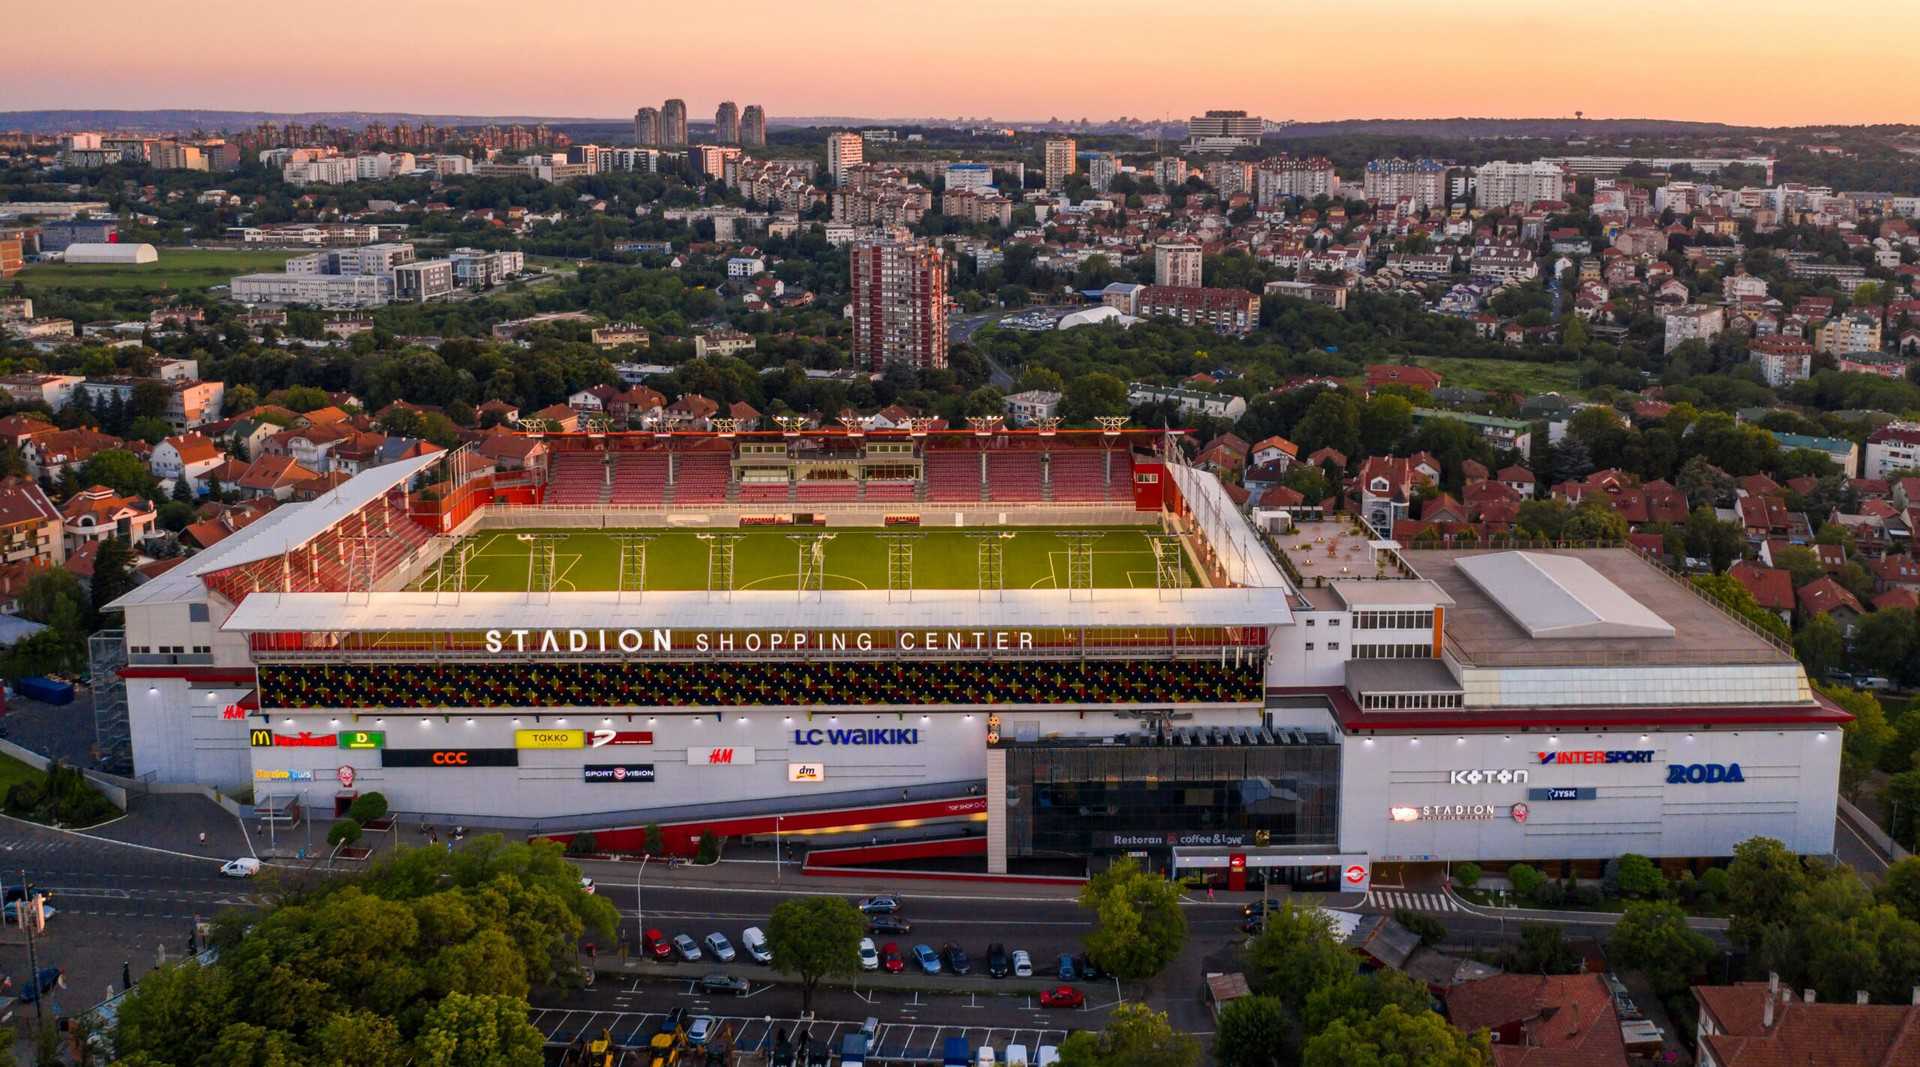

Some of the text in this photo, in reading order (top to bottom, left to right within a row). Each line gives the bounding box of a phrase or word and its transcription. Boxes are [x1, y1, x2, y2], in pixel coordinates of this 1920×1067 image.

[485, 629, 1033, 653] STADION SHOPPING CENTER
[794, 729, 823, 745] LC
[432, 752, 468, 764] CCC
[709, 749, 733, 763] H&M
[1556, 751, 1655, 764] INTERSPORT
[585, 768, 654, 777] SPORT VISION
[799, 765, 815, 775] dm
[1666, 764, 1744, 784] RODA
[1553, 789, 1576, 798] JYSK
[1423, 804, 1495, 816] STADION
[1114, 835, 1162, 845] Restoran
[1180, 834, 1211, 844] coffee
